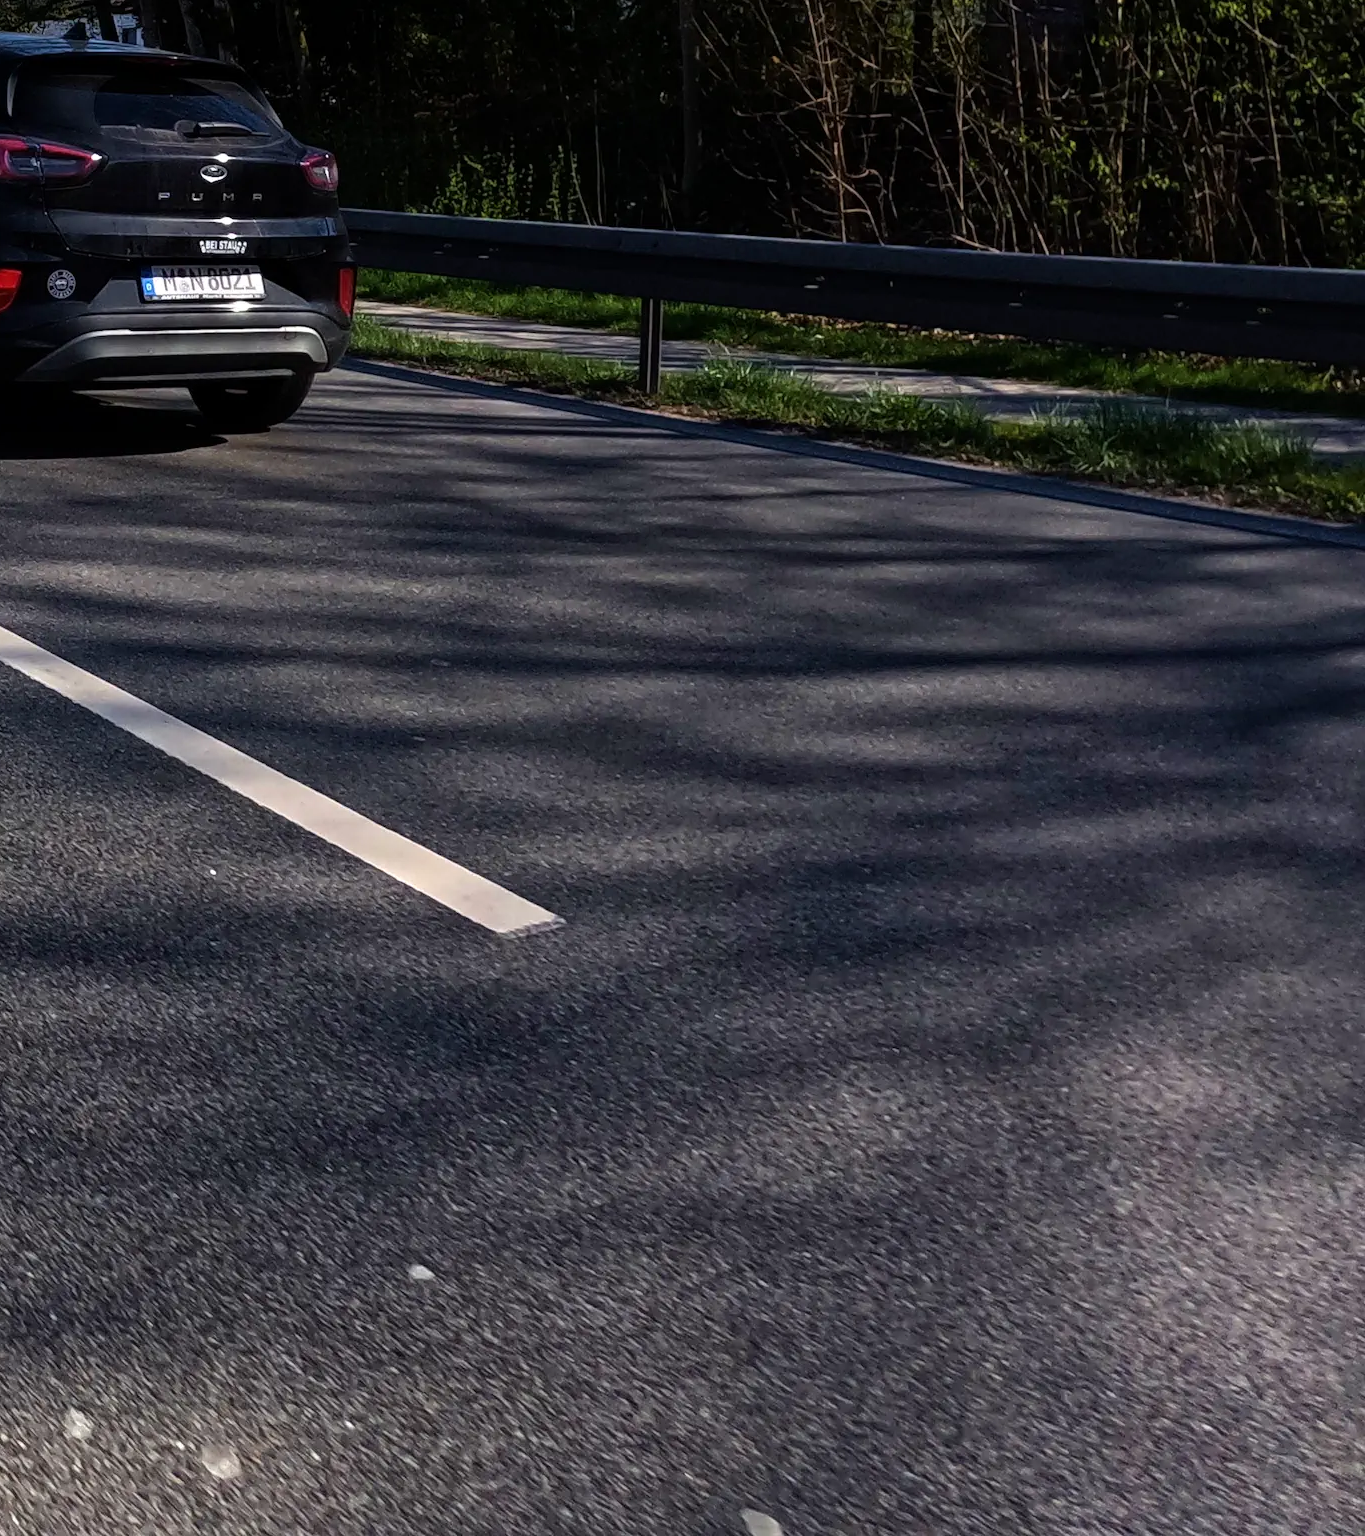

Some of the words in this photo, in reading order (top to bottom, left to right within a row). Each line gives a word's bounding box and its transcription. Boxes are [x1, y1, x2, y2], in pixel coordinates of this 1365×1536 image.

[157, 192, 263, 202] PUMA
[205, 240, 218, 250] BEI
[218, 240, 237, 250] STAU
[207, 267, 257, 291] 8021
